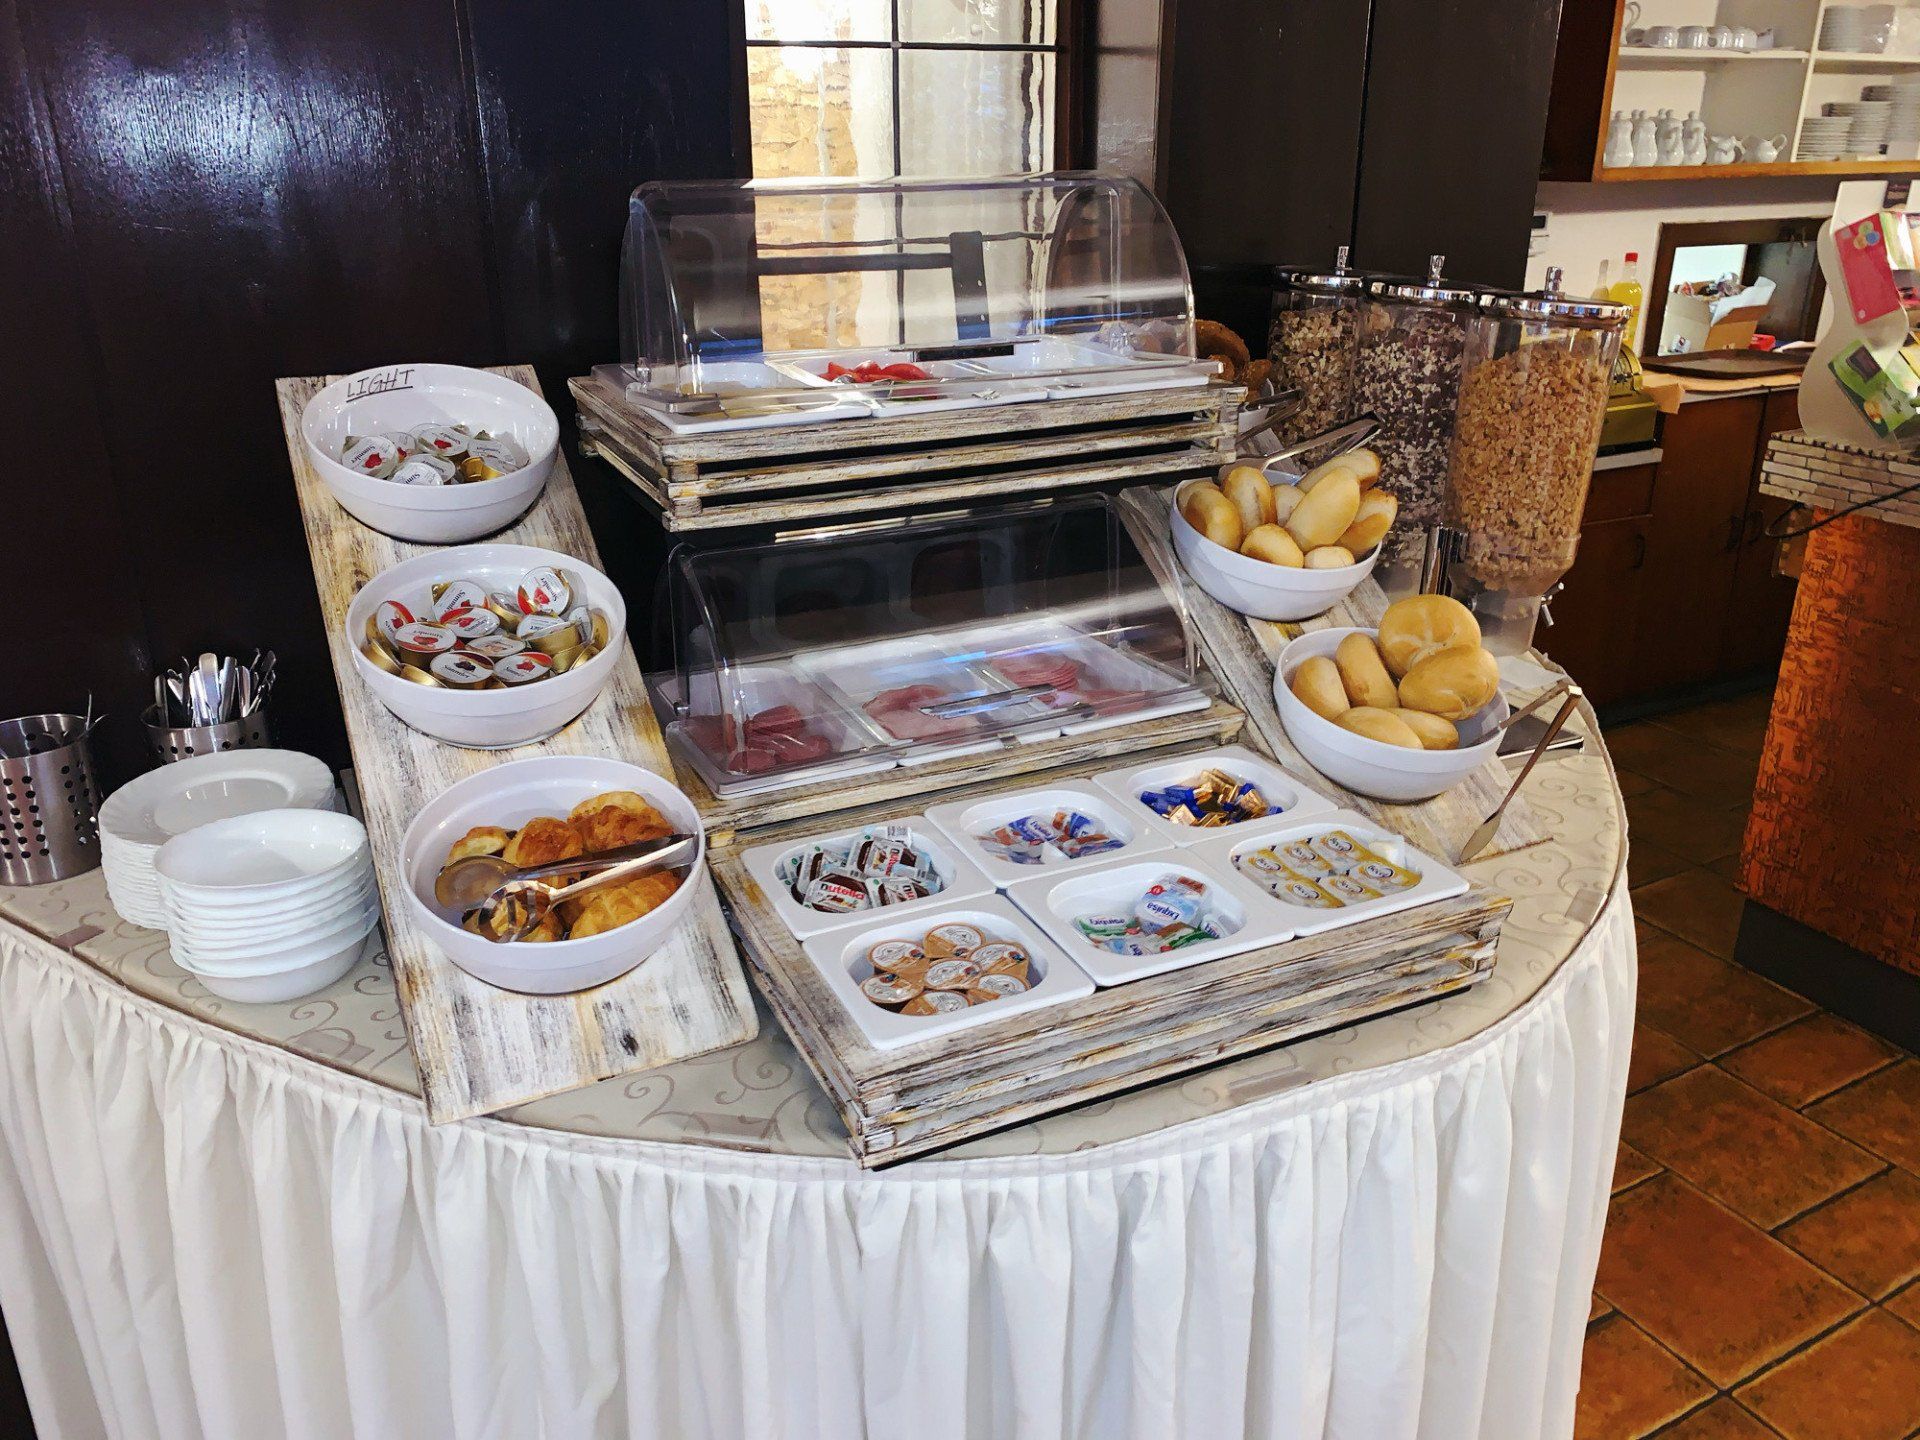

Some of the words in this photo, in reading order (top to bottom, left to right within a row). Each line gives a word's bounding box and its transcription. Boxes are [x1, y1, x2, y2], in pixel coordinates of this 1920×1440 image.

[347, 368, 415, 400] LIGHT
[820, 883, 866, 901] nutella
[1145, 901, 1181, 921] Exquisa
